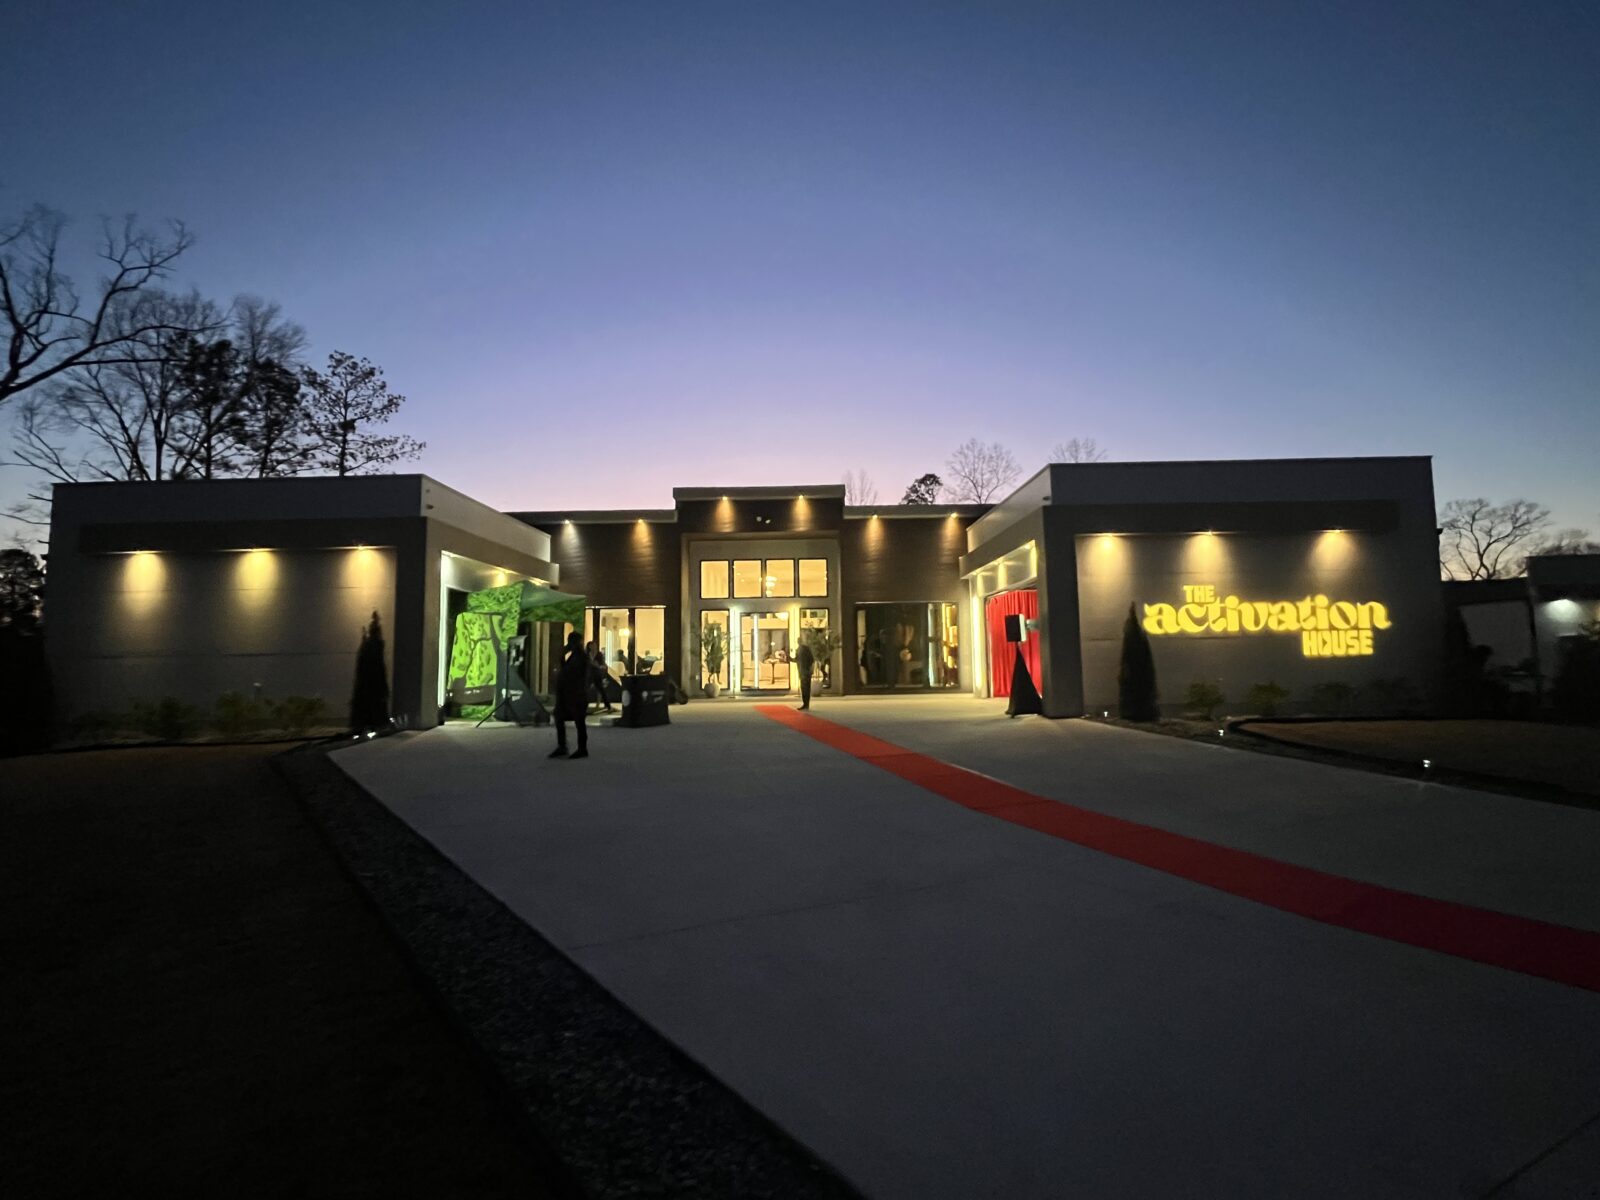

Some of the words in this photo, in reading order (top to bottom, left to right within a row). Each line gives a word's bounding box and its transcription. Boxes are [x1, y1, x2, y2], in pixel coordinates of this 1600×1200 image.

[1183, 585, 1215, 603] THE
[1143, 594, 1392, 635] activation
[1302, 630, 1374, 657] HOUSE
